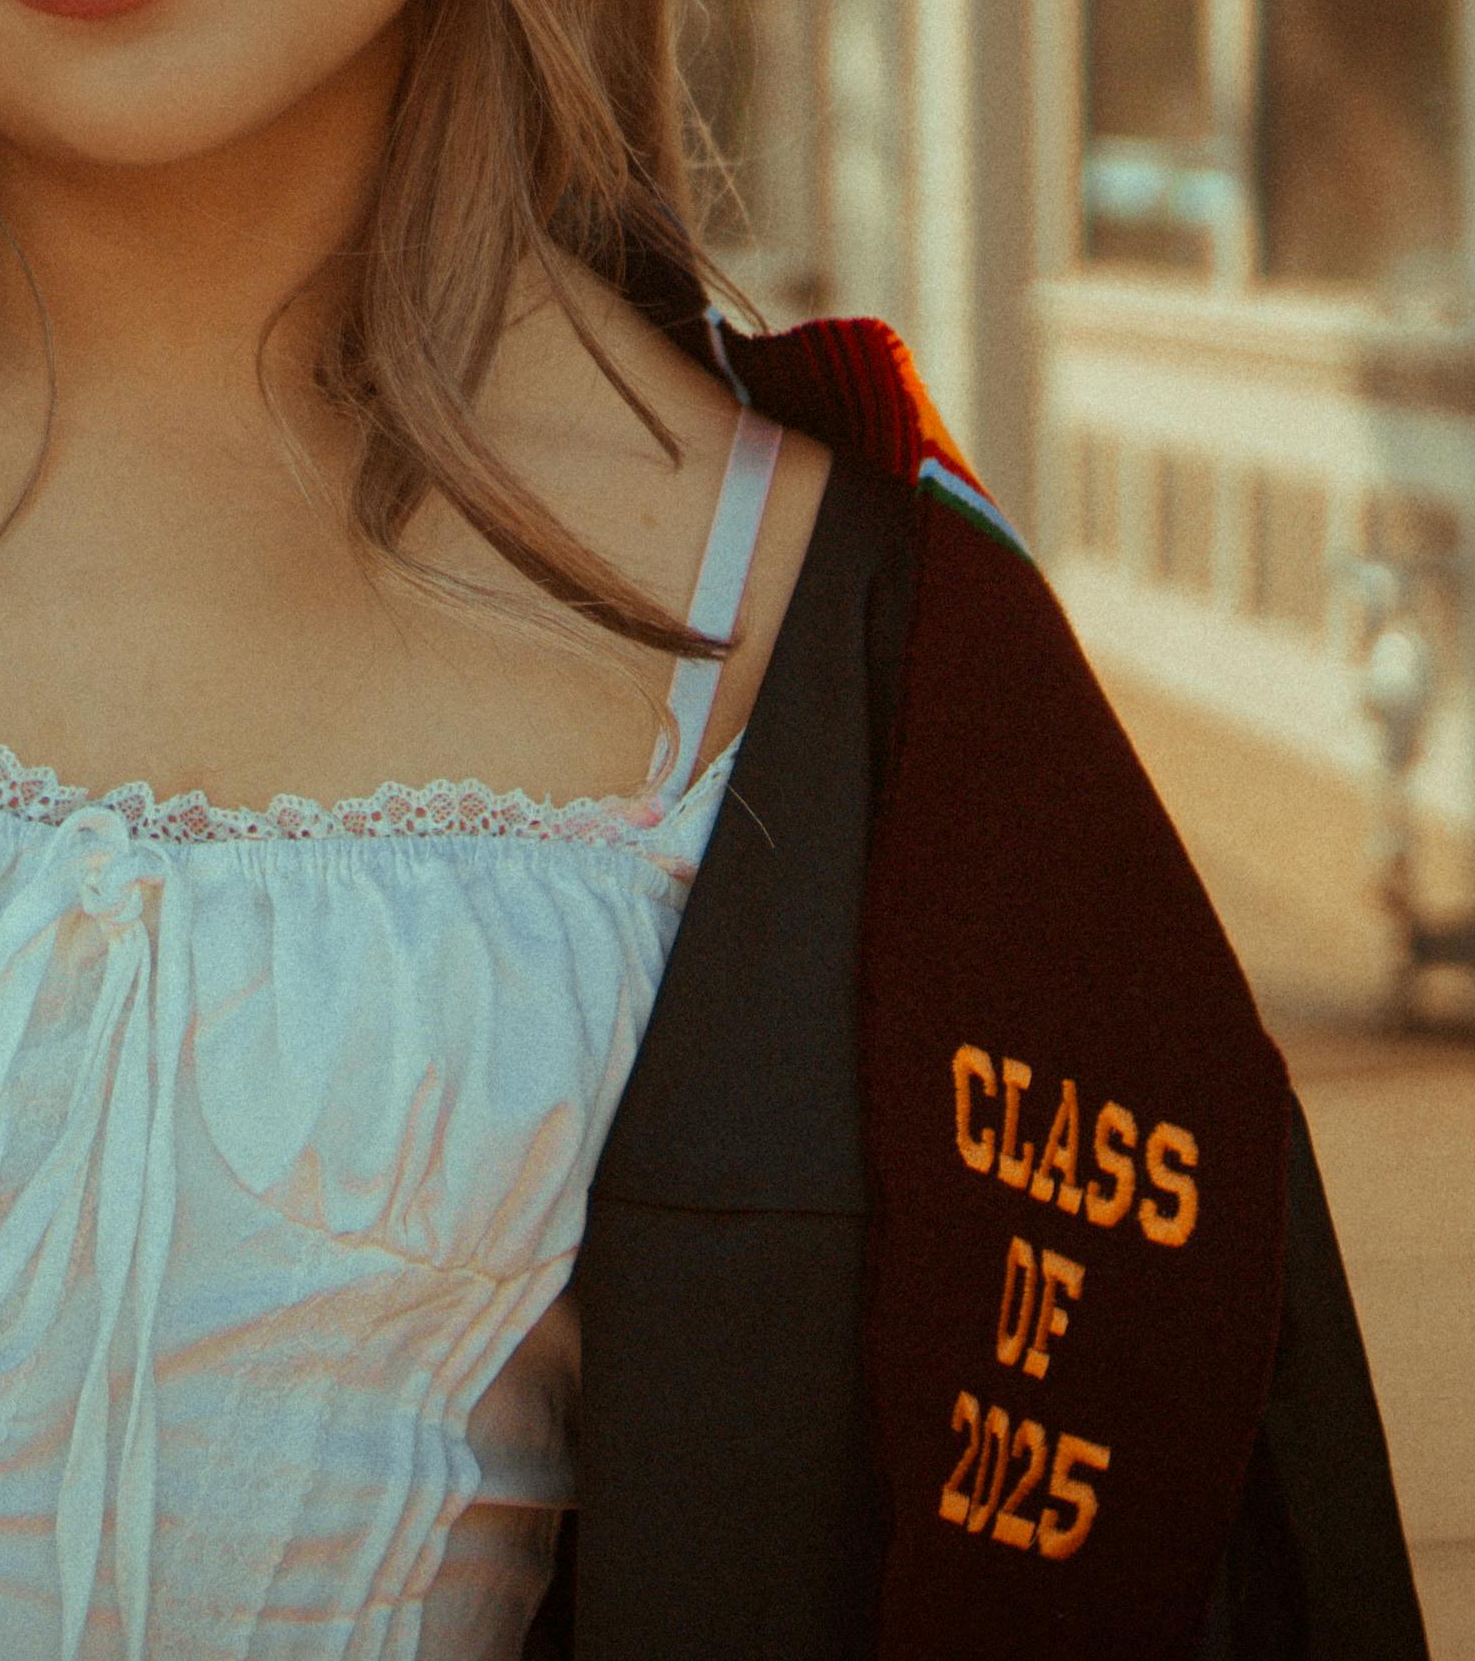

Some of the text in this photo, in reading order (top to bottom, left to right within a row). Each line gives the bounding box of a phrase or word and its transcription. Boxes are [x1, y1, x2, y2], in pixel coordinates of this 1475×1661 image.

[952, 1043, 1198, 1247] CLASS
[997, 1236, 1085, 1379] OF
[939, 1390, 1111, 1560] 2025
